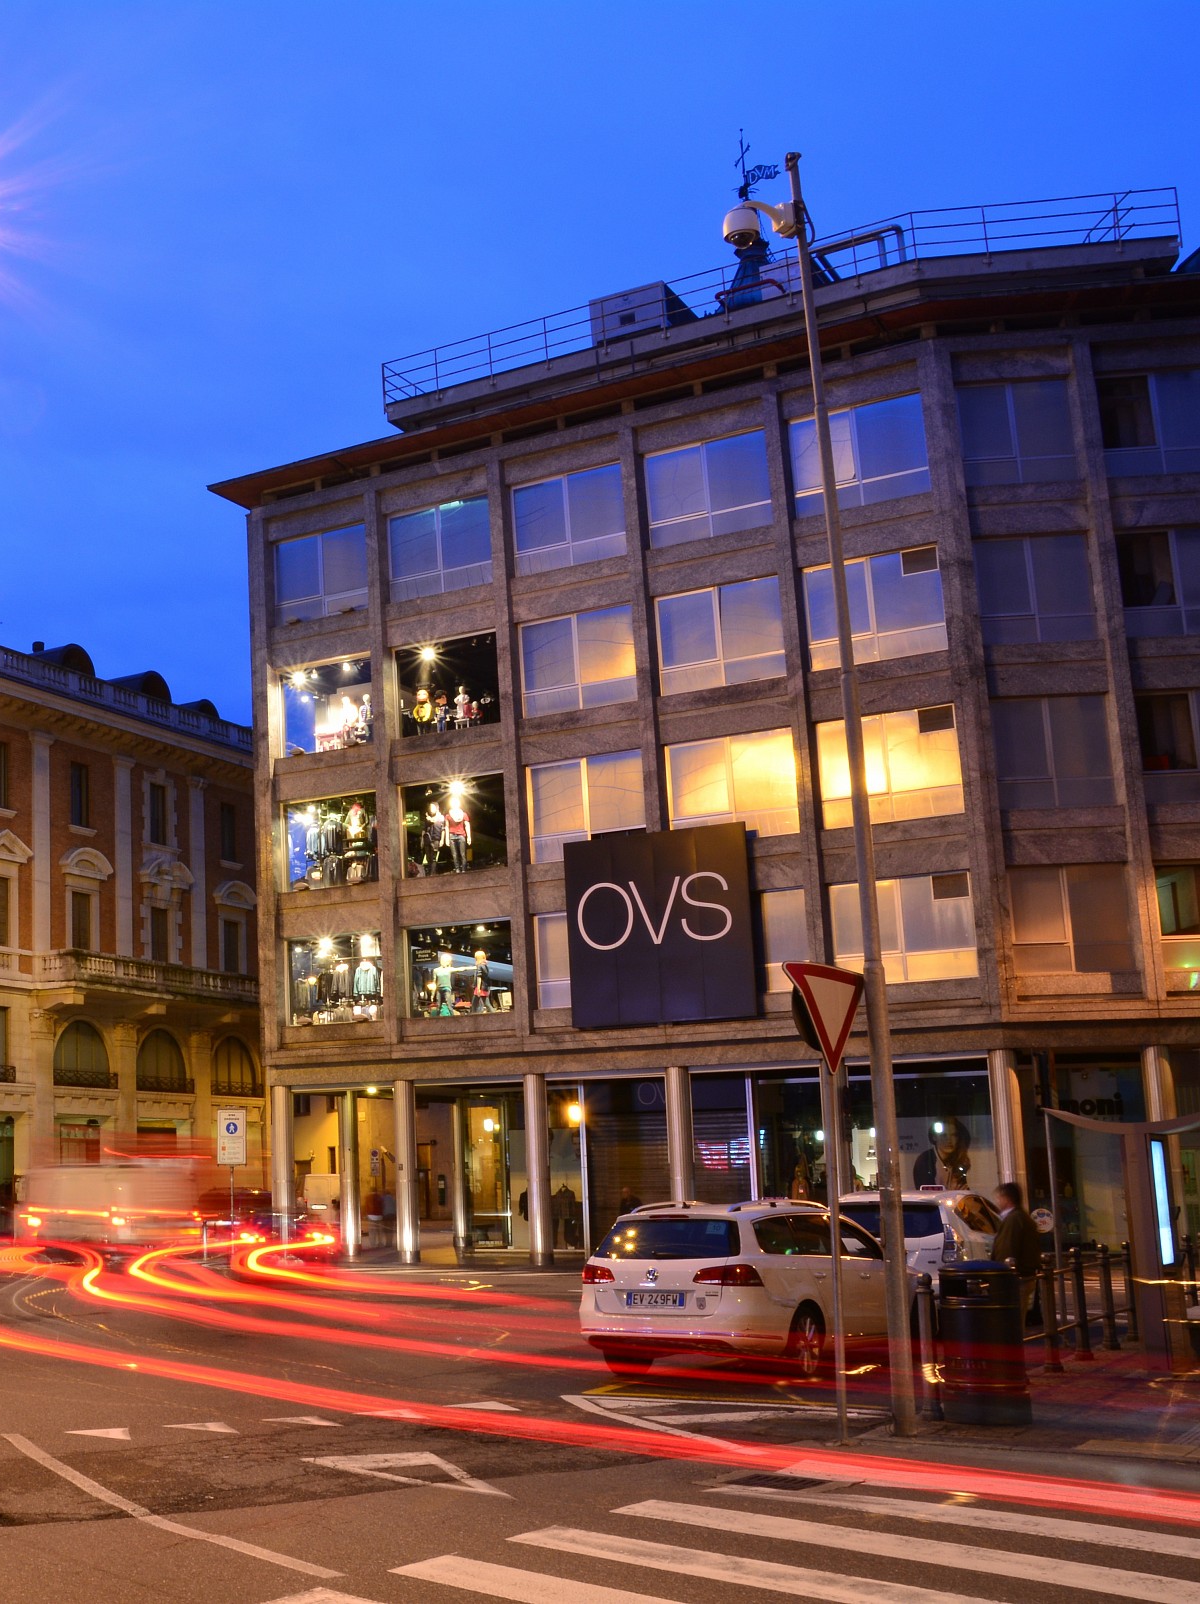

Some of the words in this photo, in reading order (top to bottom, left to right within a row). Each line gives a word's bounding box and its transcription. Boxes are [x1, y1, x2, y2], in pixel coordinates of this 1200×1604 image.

[577, 871, 733, 950] OVS
[638, 1081, 666, 1105] OV
[633, 1293, 645, 1305] EV
[648, 1293, 678, 1305] 249FW
